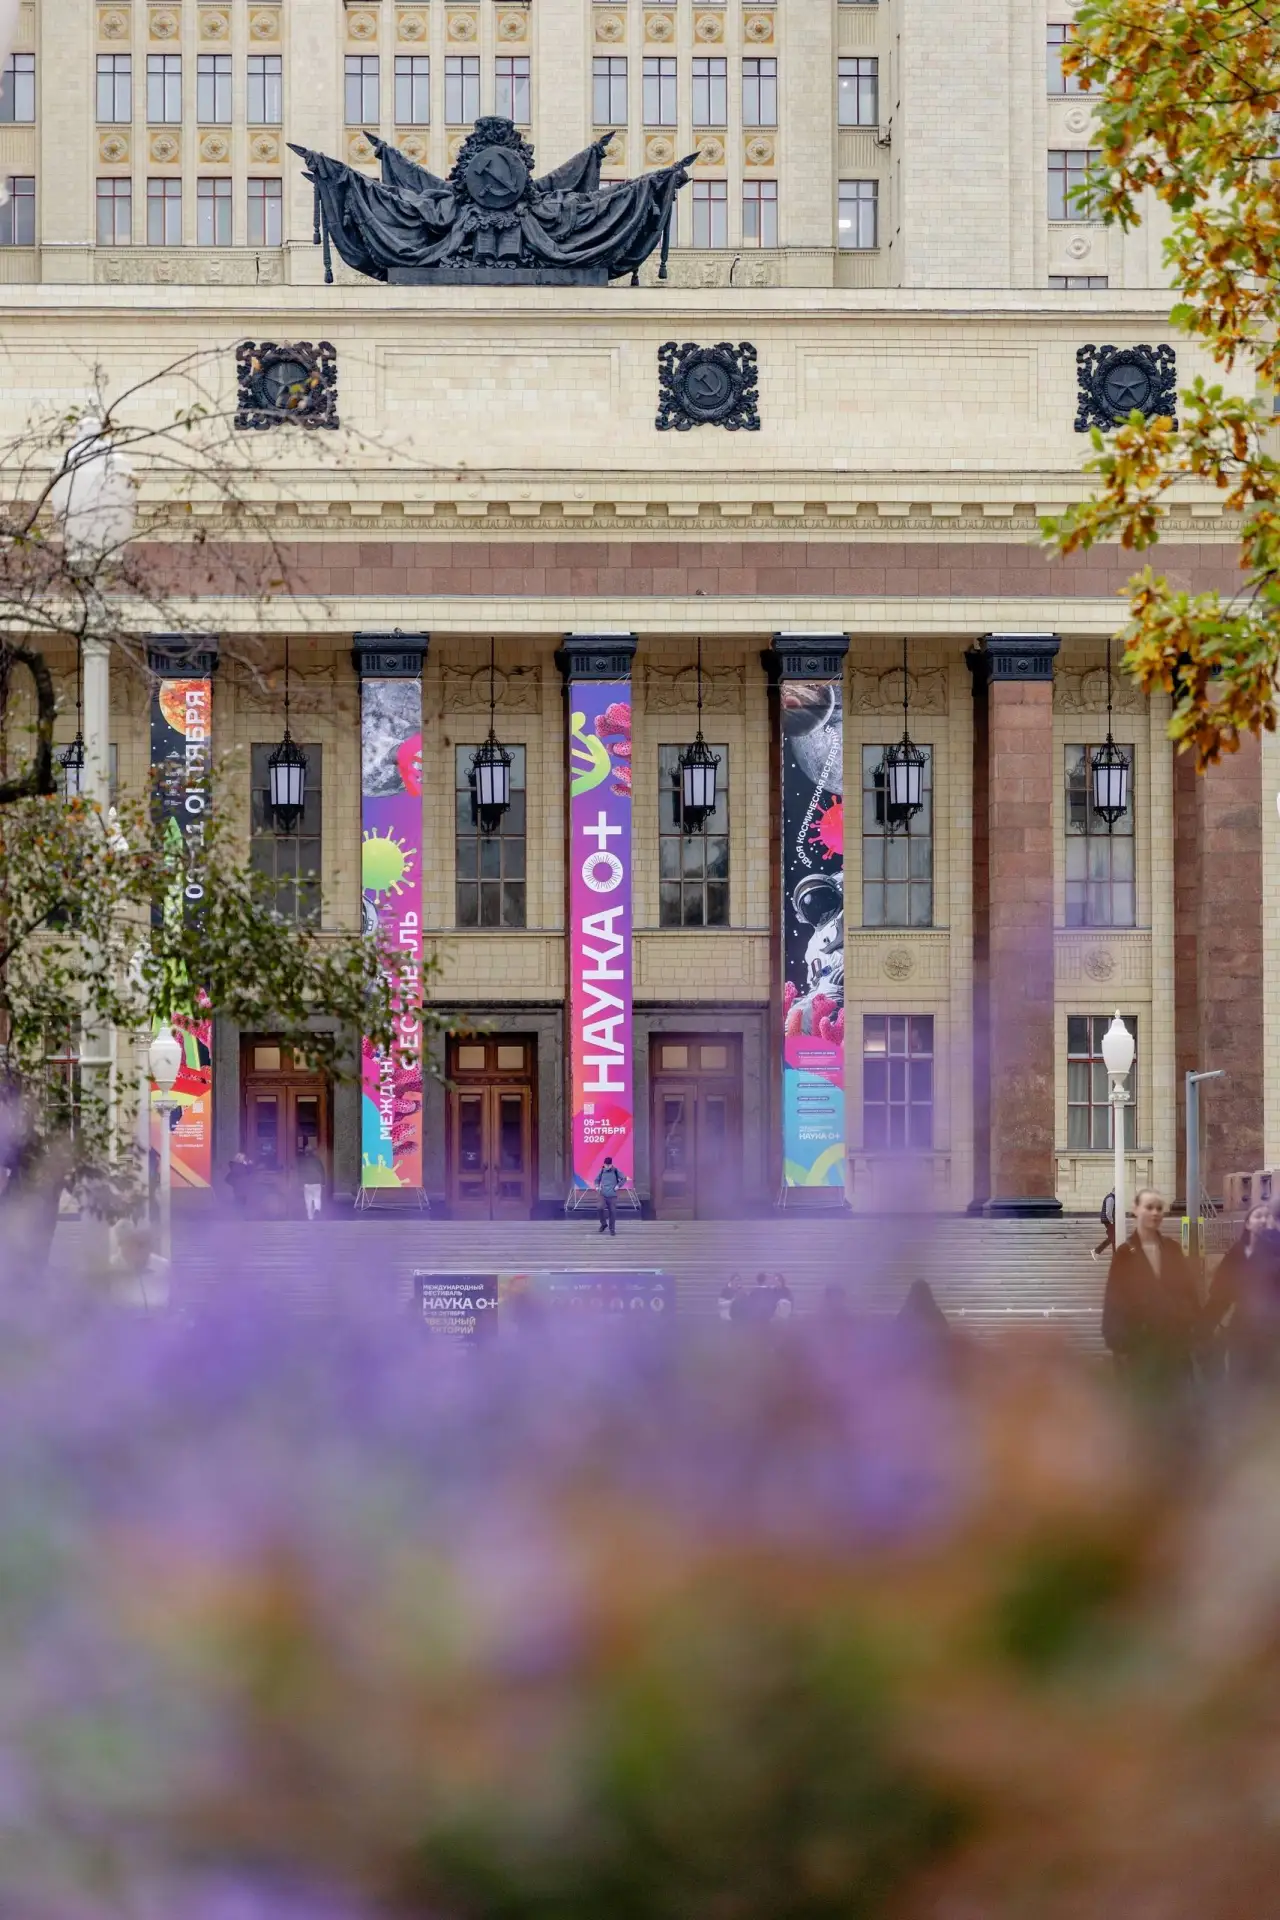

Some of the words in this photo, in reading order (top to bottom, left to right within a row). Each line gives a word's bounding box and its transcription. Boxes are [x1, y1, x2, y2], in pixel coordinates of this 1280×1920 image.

[821, 725, 839, 779] ВСЕЛЕННАЯ
[796, 779, 826, 845] КОСМИЧЕСКАЯ
[796, 843, 812, 868] ТВОЯ
[399, 911, 419, 1071] ЕСИВЛЬ
[582, 905, 625, 1092] НАУКА
[378, 970, 394, 1141] МЕЖДУНЙ
[583, 1127, 626, 1136] ОКТЯБРЯ
[583, 1136, 605, 1144] 2026
[799, 1132, 827, 1141] НАУКА
[423, 1298, 473, 1309] НАУКА
